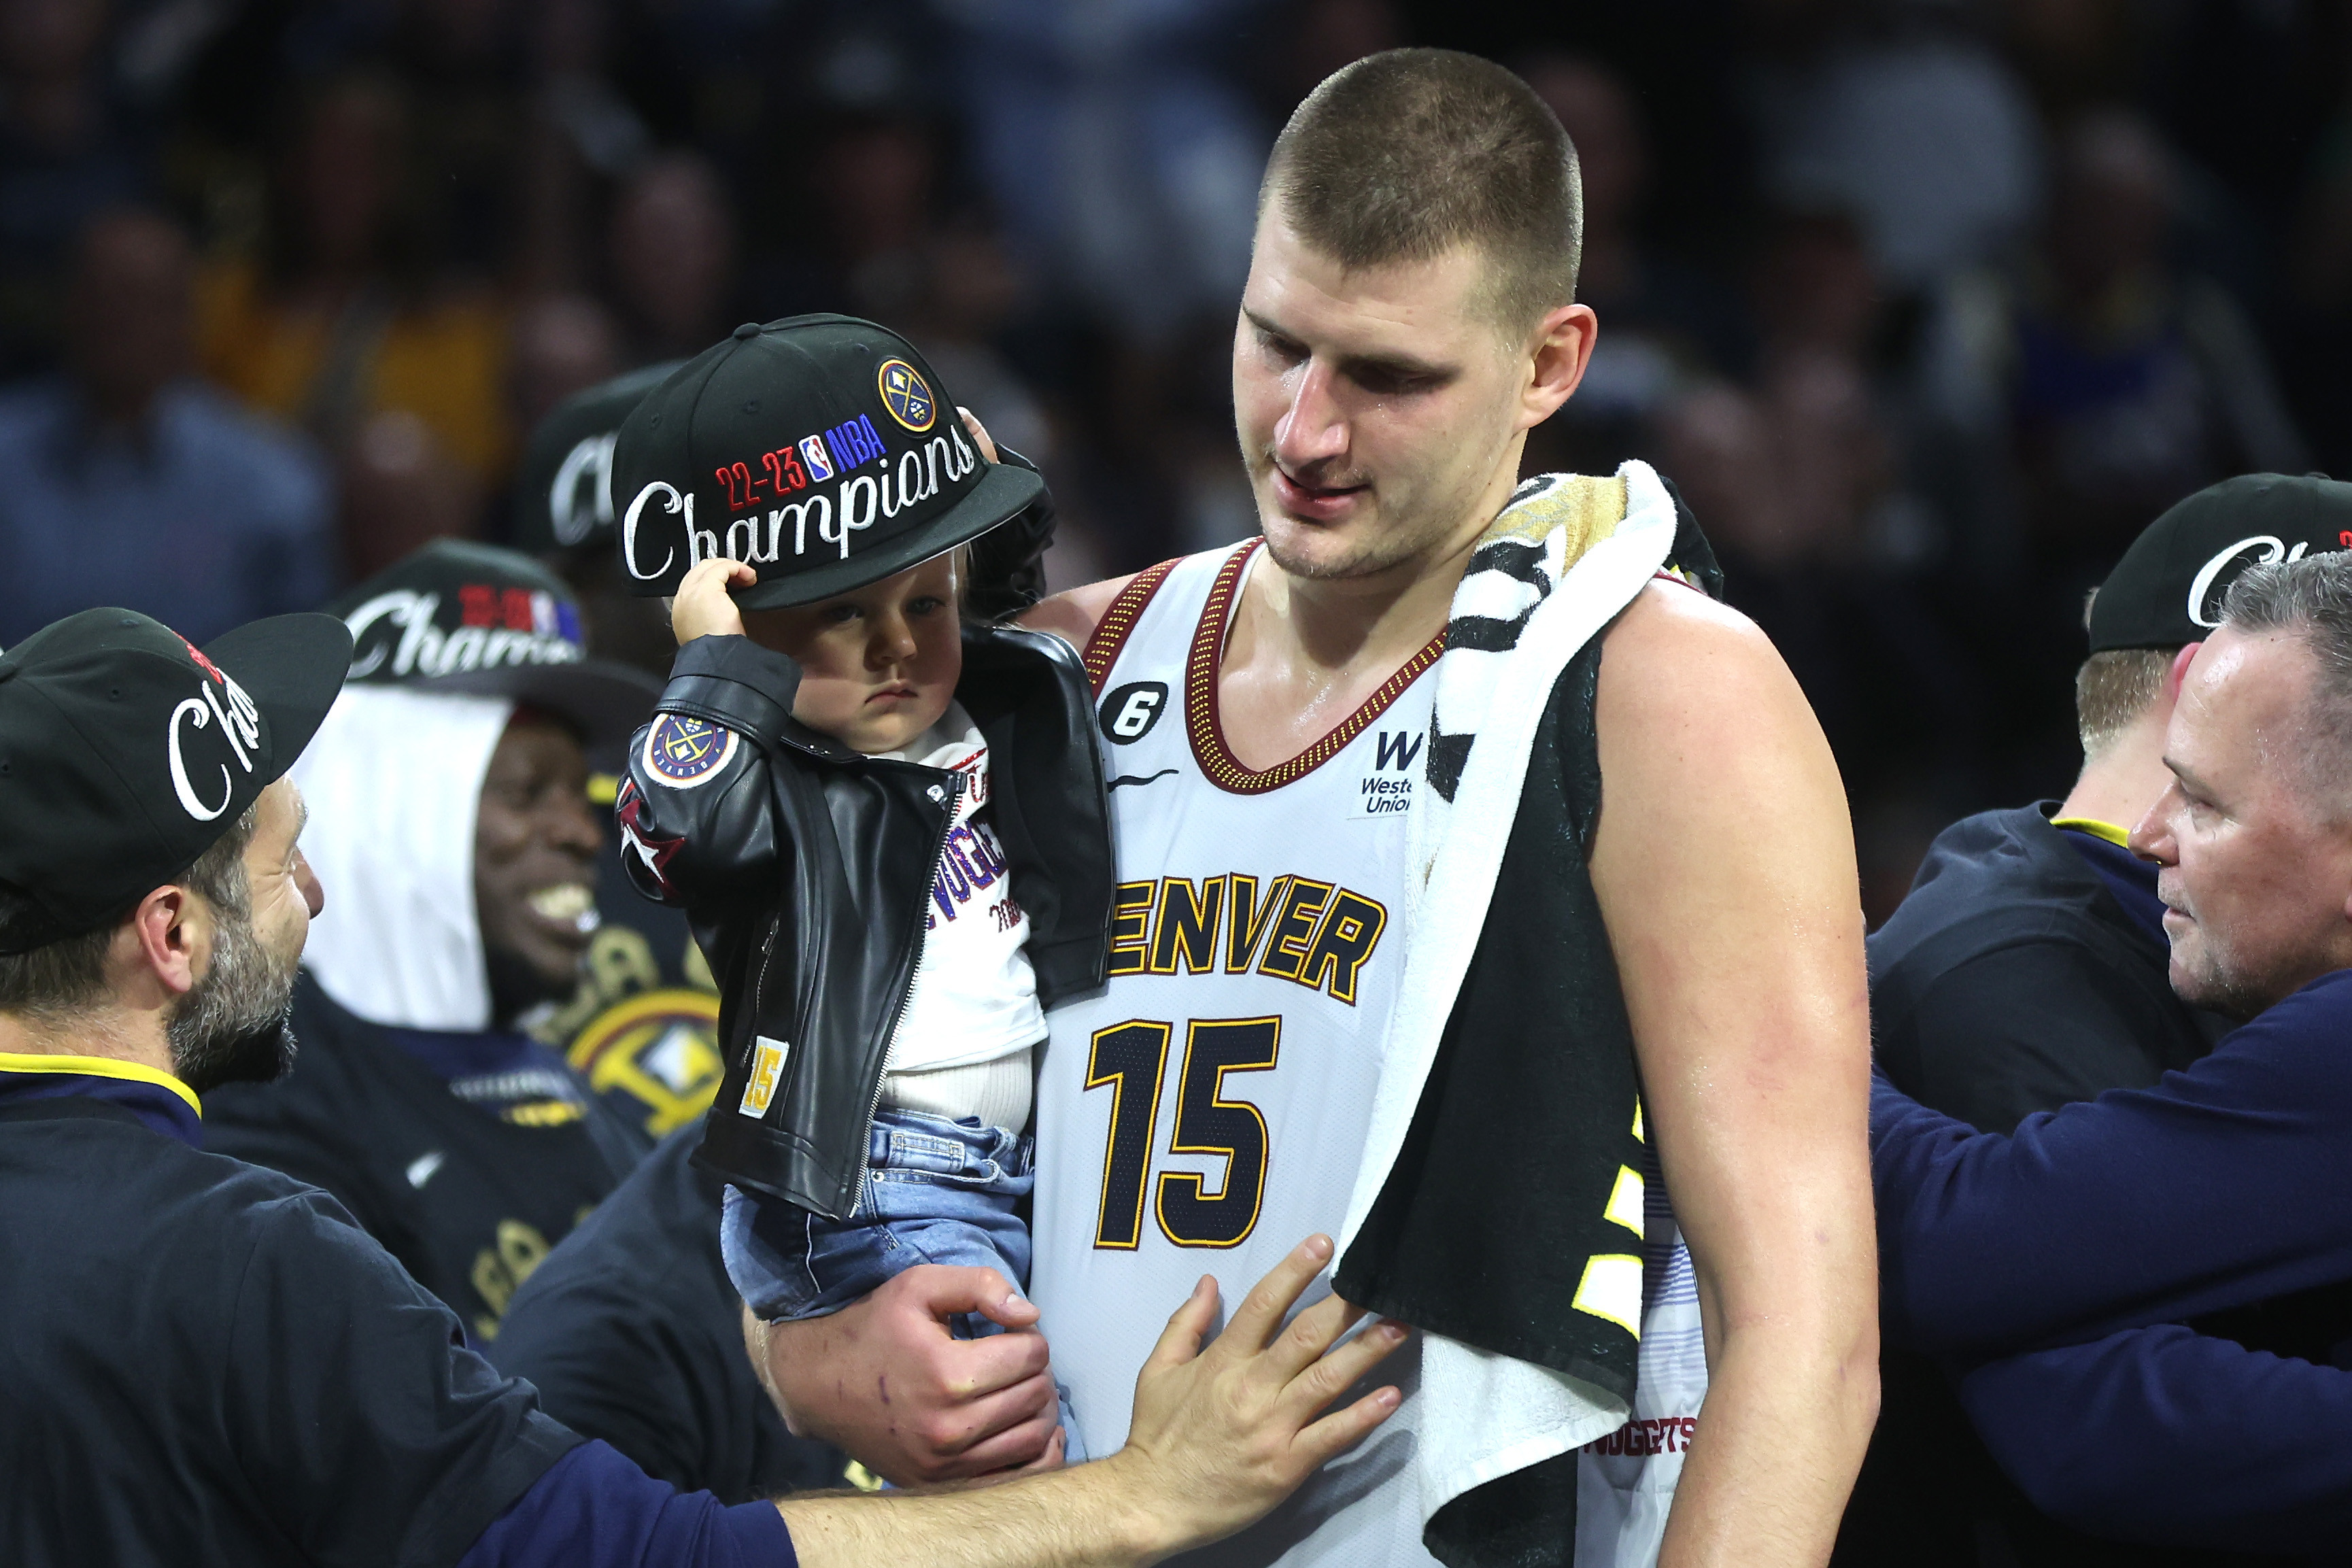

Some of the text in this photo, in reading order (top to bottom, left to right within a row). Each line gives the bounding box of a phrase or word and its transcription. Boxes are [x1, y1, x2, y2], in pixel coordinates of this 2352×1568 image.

[624, 424, 976, 581] Champions
[715, 413, 887, 512] 22-23 NBA
[1112, 689, 1160, 737] 6
[653, 749, 709, 777] DENVER
[1106, 871, 1388, 1006] ENVER
[745, 1045, 782, 1110] 15
[1083, 1014, 1282, 1251] 15
